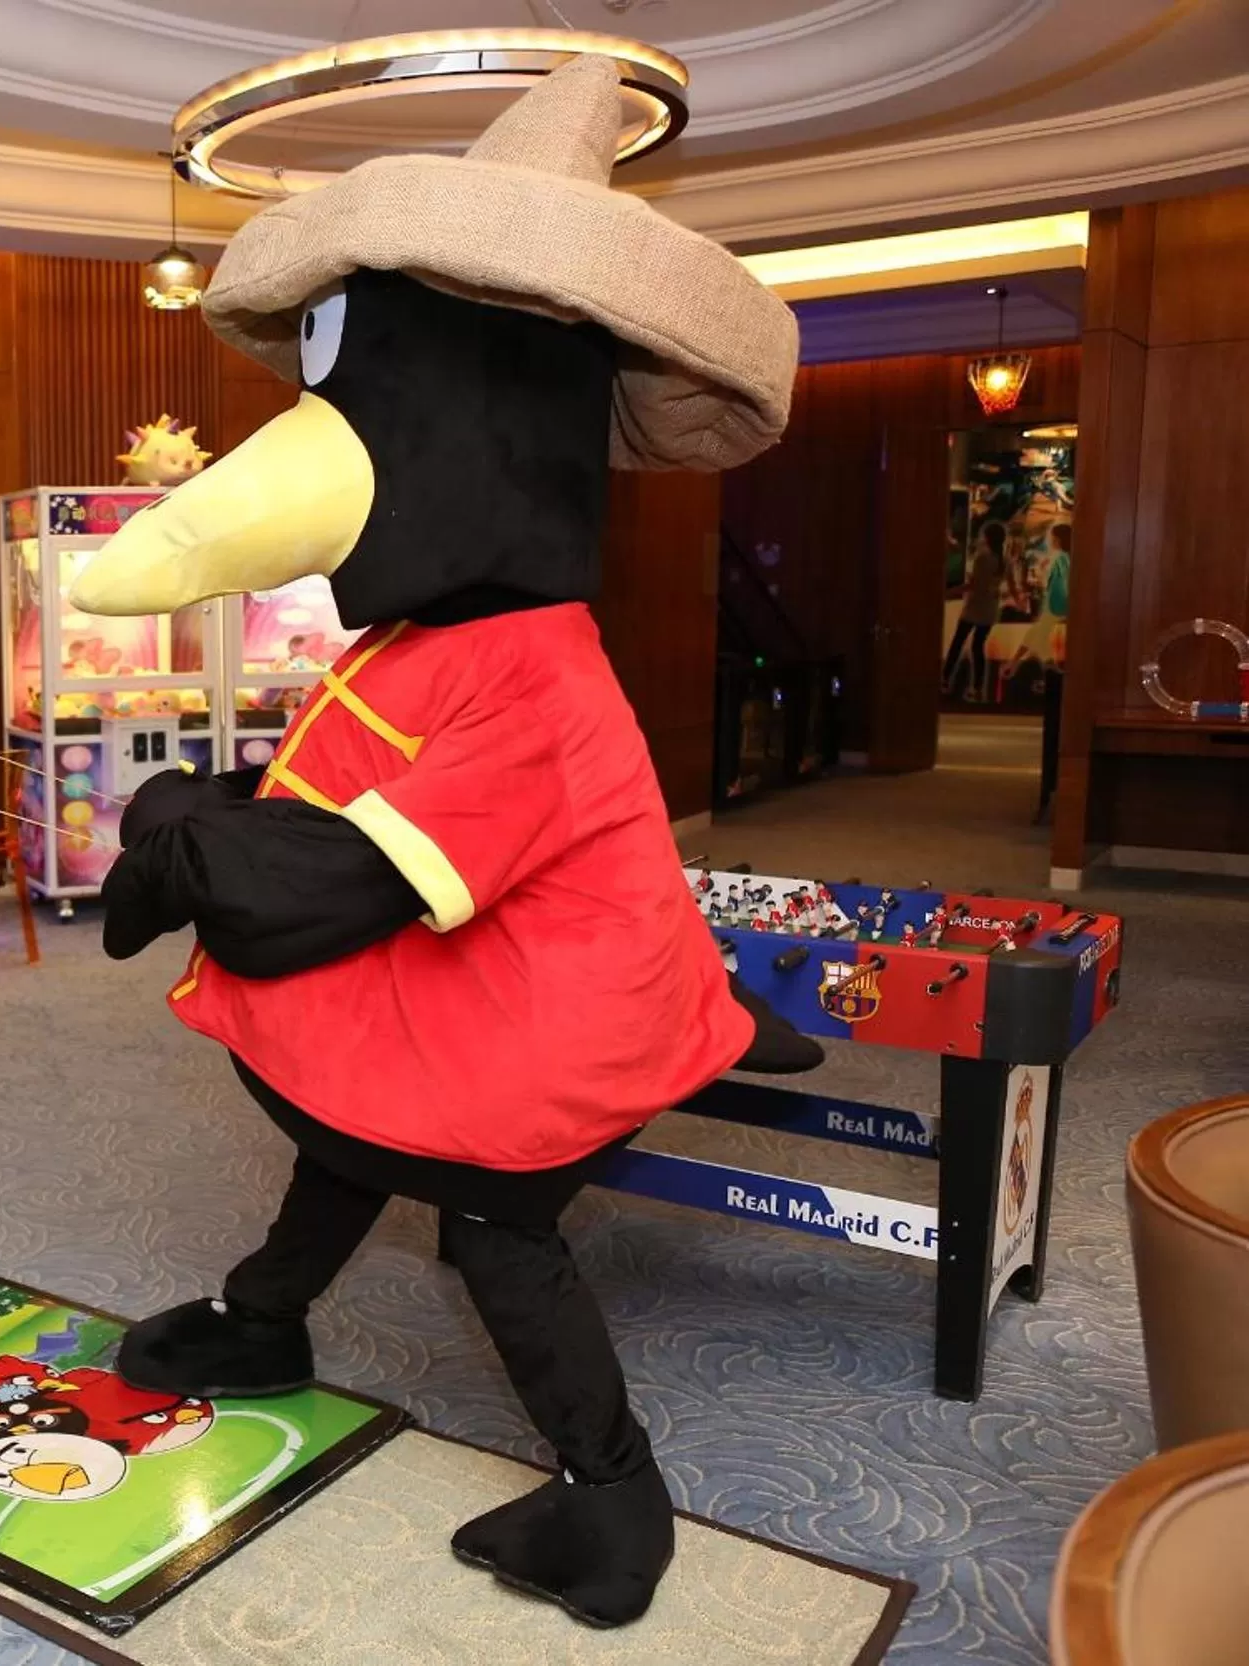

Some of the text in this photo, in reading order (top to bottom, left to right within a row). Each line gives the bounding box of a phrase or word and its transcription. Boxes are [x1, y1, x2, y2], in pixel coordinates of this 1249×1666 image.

[826, 1110, 876, 1138] Real
[726, 1185, 780, 1217] Real
[788, 1198, 879, 1238] Madrid
